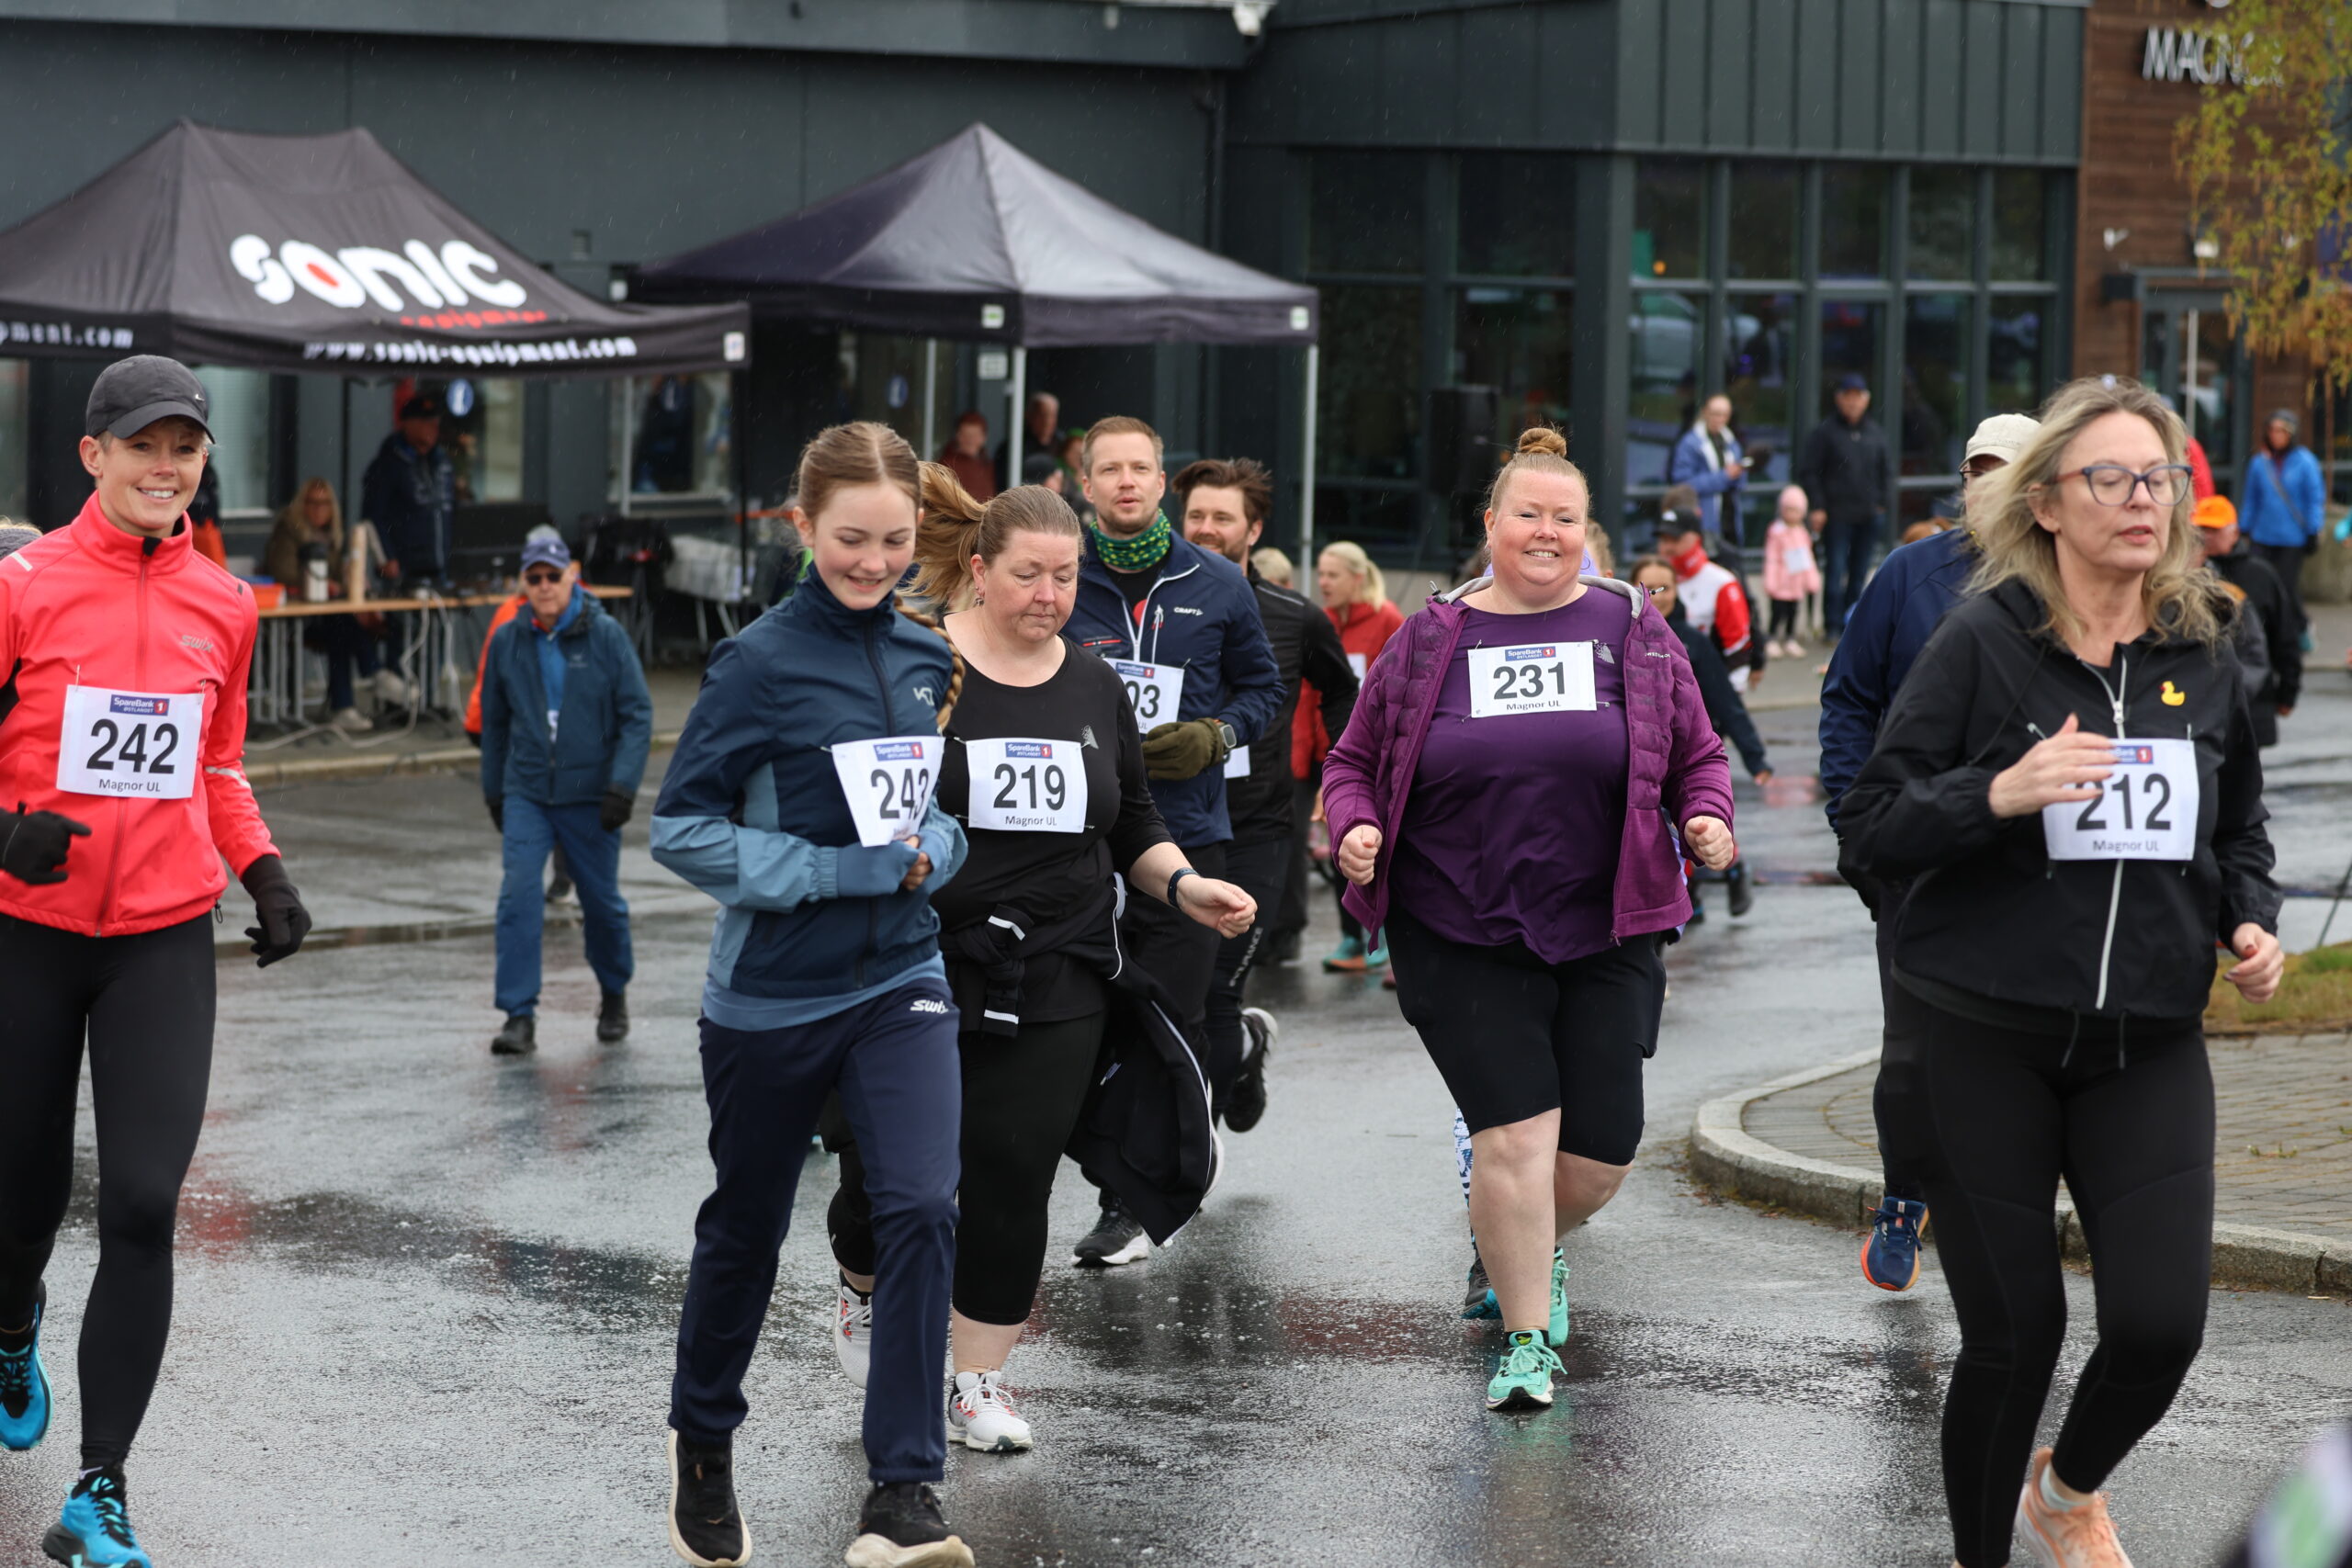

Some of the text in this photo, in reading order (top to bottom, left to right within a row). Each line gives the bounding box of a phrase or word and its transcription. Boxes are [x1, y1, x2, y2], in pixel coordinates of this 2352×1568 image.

[2142, 26, 2285, 87] MAGN
[230, 234, 527, 311] sonic
[302, 336, 638, 366] www.sonic-equipment.com
[1508, 648, 1543, 657] SpareBank
[1493, 661, 1566, 700] 231
[114, 697, 154, 707] SpareBank
[1125, 681, 1160, 718] 03
[1506, 701, 1545, 711] Magnor
[86, 718, 179, 774] 242
[99, 779, 161, 793] Magnor UL
[993, 763, 1066, 811] 219
[2075, 773, 2171, 831] 212
[1005, 816, 1057, 827] Magnor UL
[2093, 840, 2159, 852] Magnor UL
